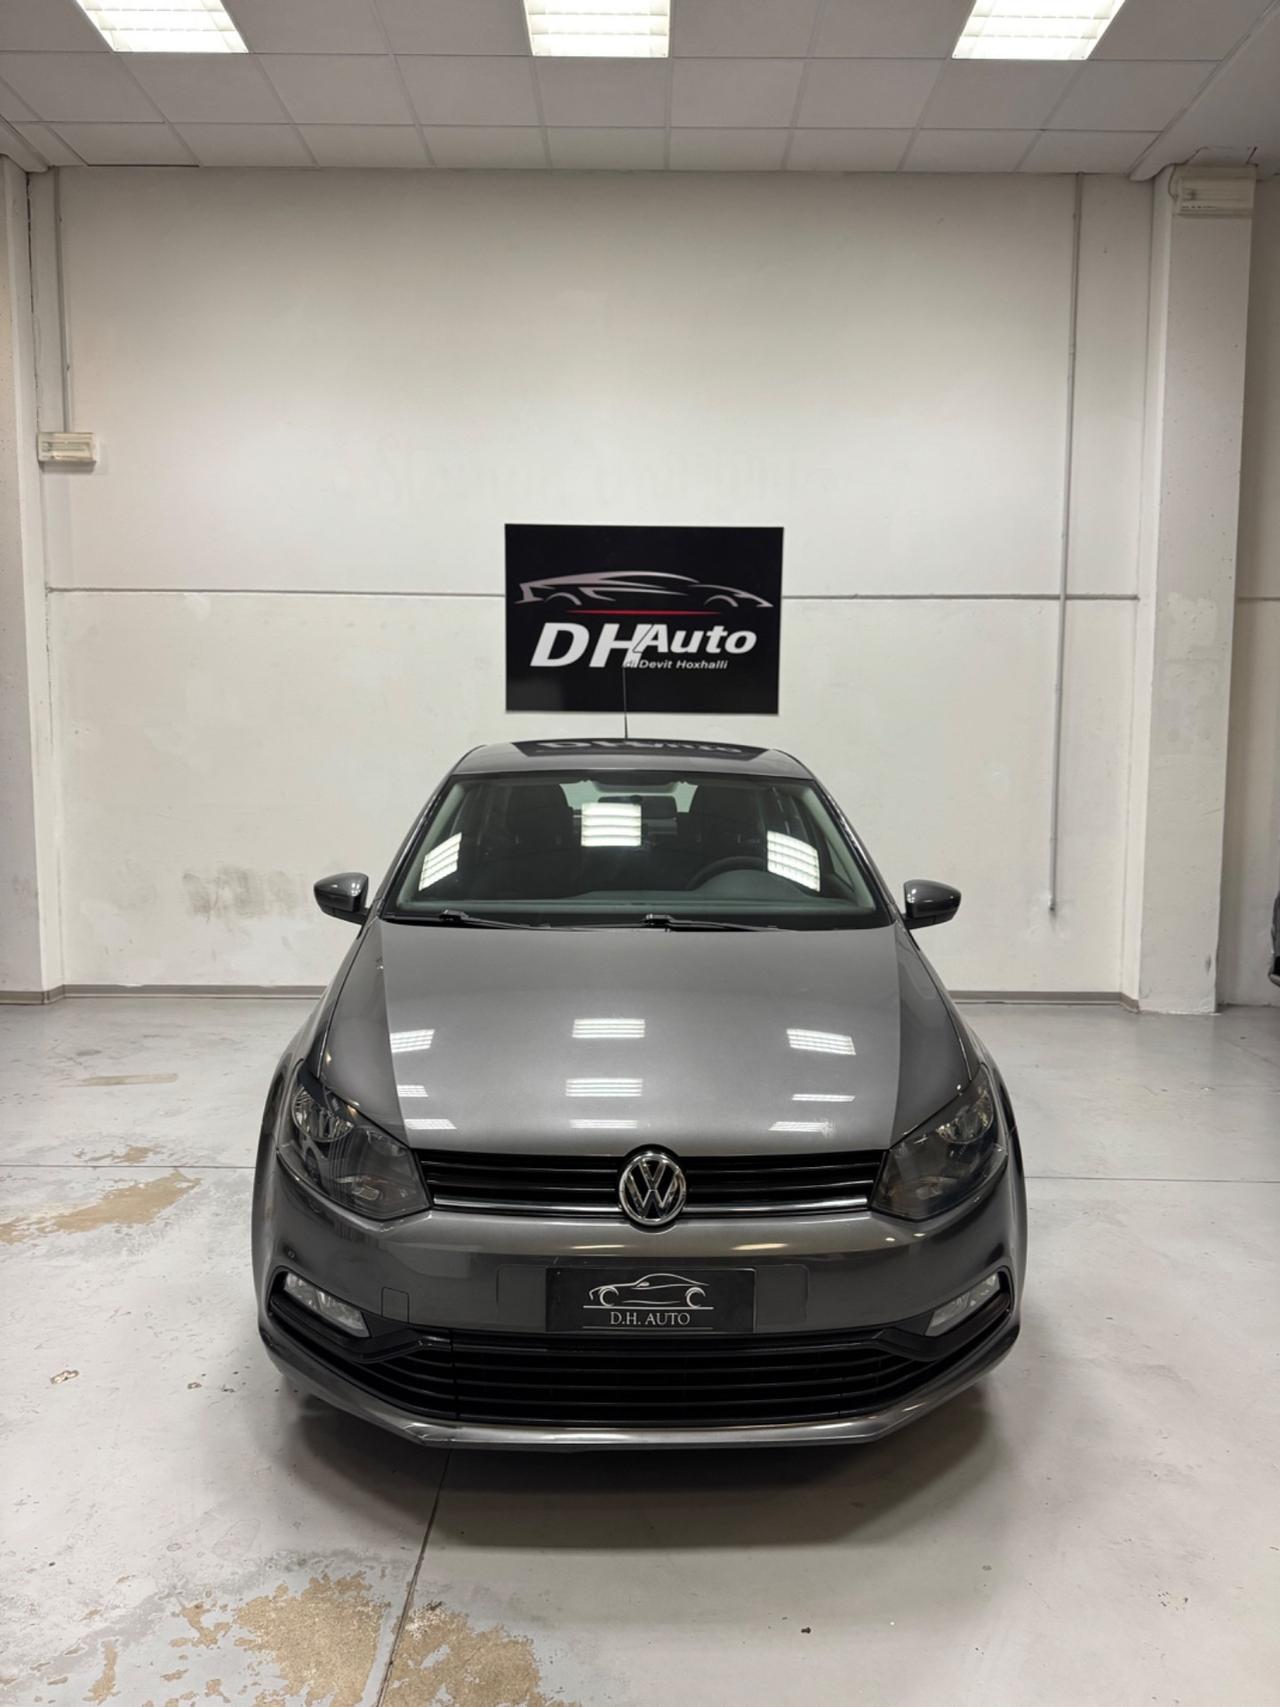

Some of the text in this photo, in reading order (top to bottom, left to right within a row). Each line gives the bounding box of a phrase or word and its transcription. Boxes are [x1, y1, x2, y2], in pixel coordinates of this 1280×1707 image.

[639, 659, 673, 669] Devit
[676, 659, 729, 669] Hoxhalli
[610, 1311, 691, 1326] D.H. AUTO
